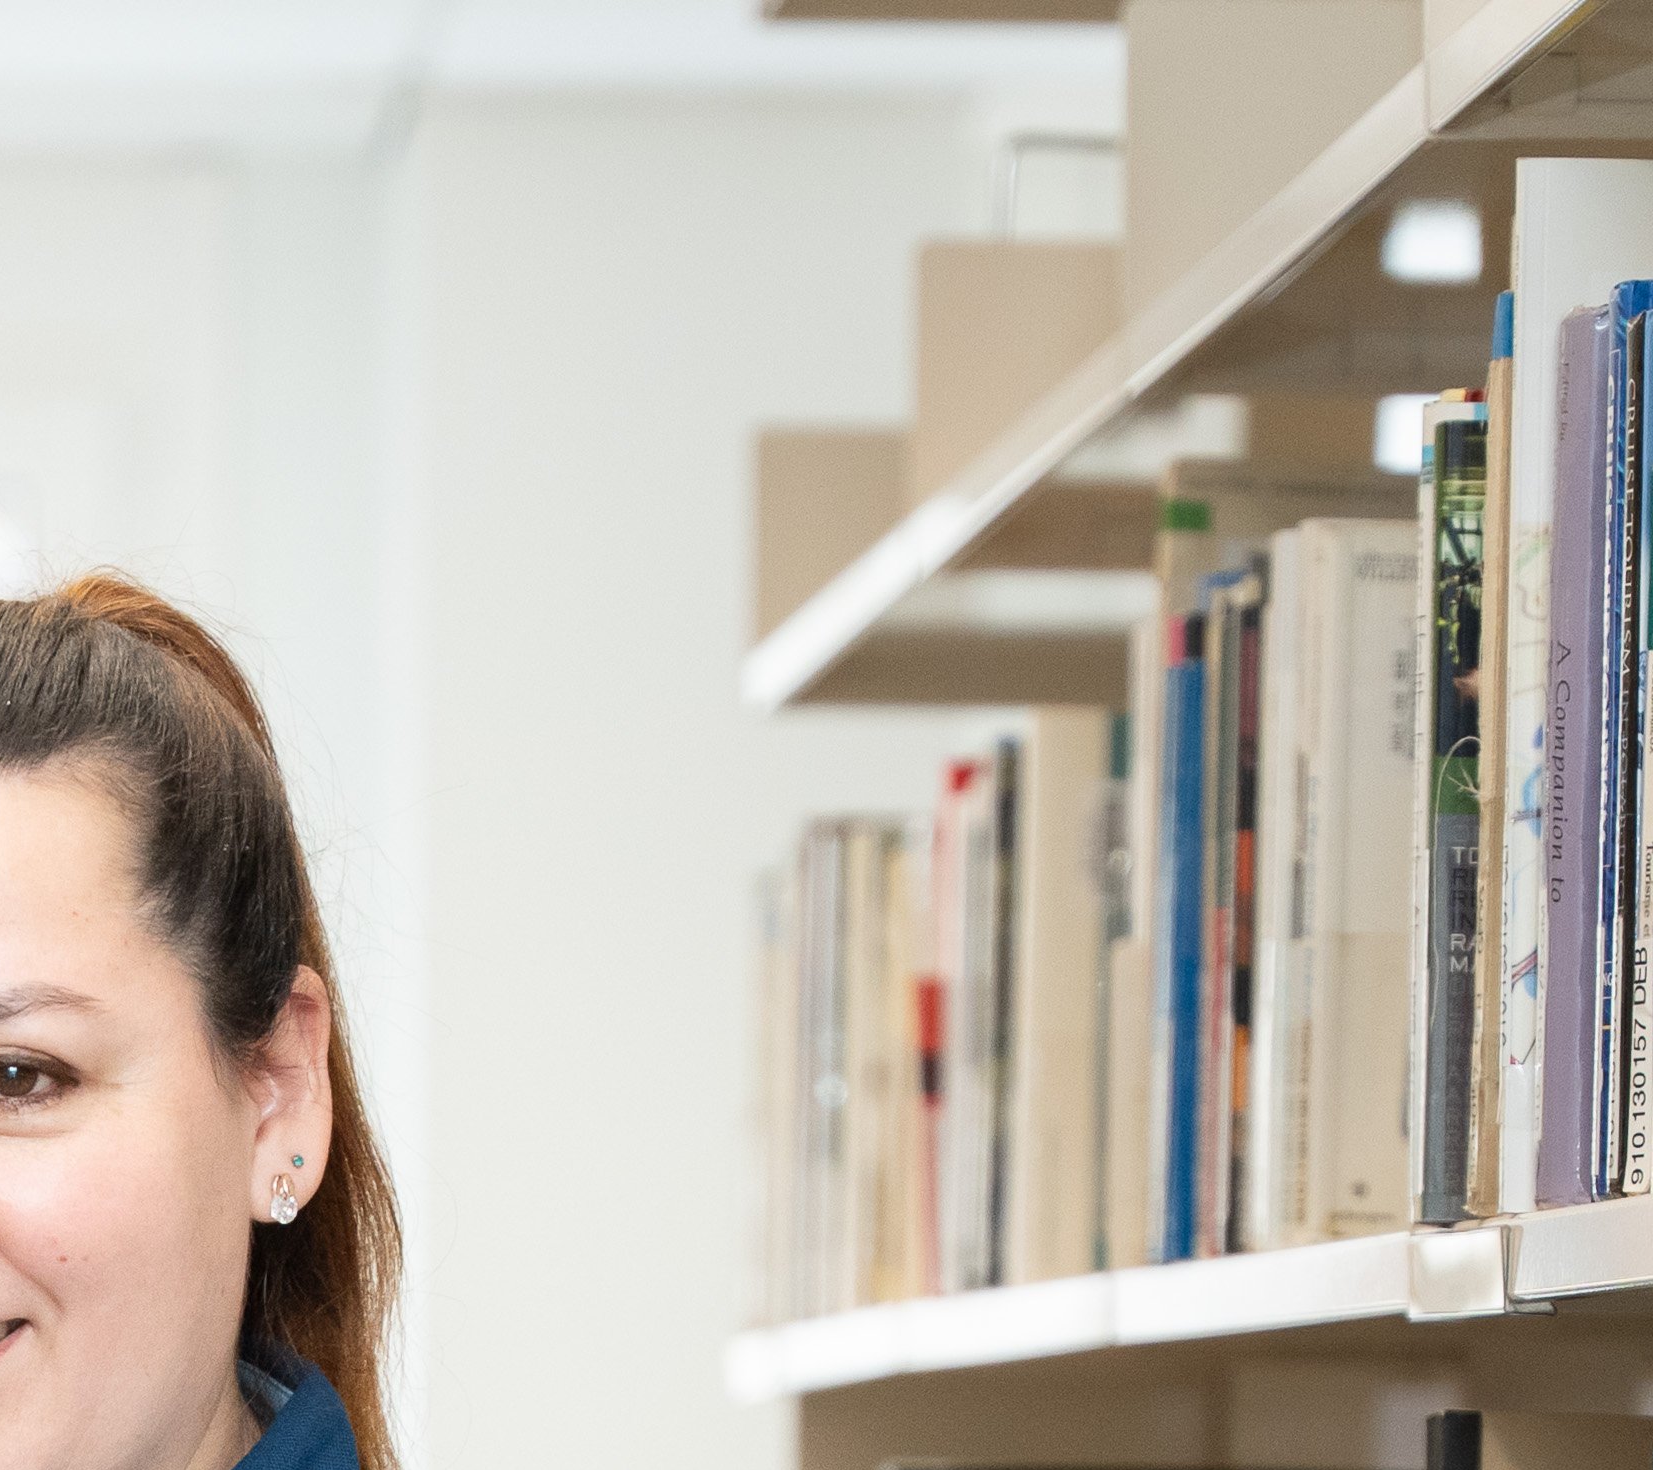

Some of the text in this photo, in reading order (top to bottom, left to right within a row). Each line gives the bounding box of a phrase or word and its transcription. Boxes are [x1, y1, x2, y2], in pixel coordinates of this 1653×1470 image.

[1623, 377, 1637, 501] CRUISE
[1620, 513, 1634, 677] TOURISM
[1548, 639, 1571, 903] A Companion to
[1624, 946, 1653, 1185] 910.130157 DEB
